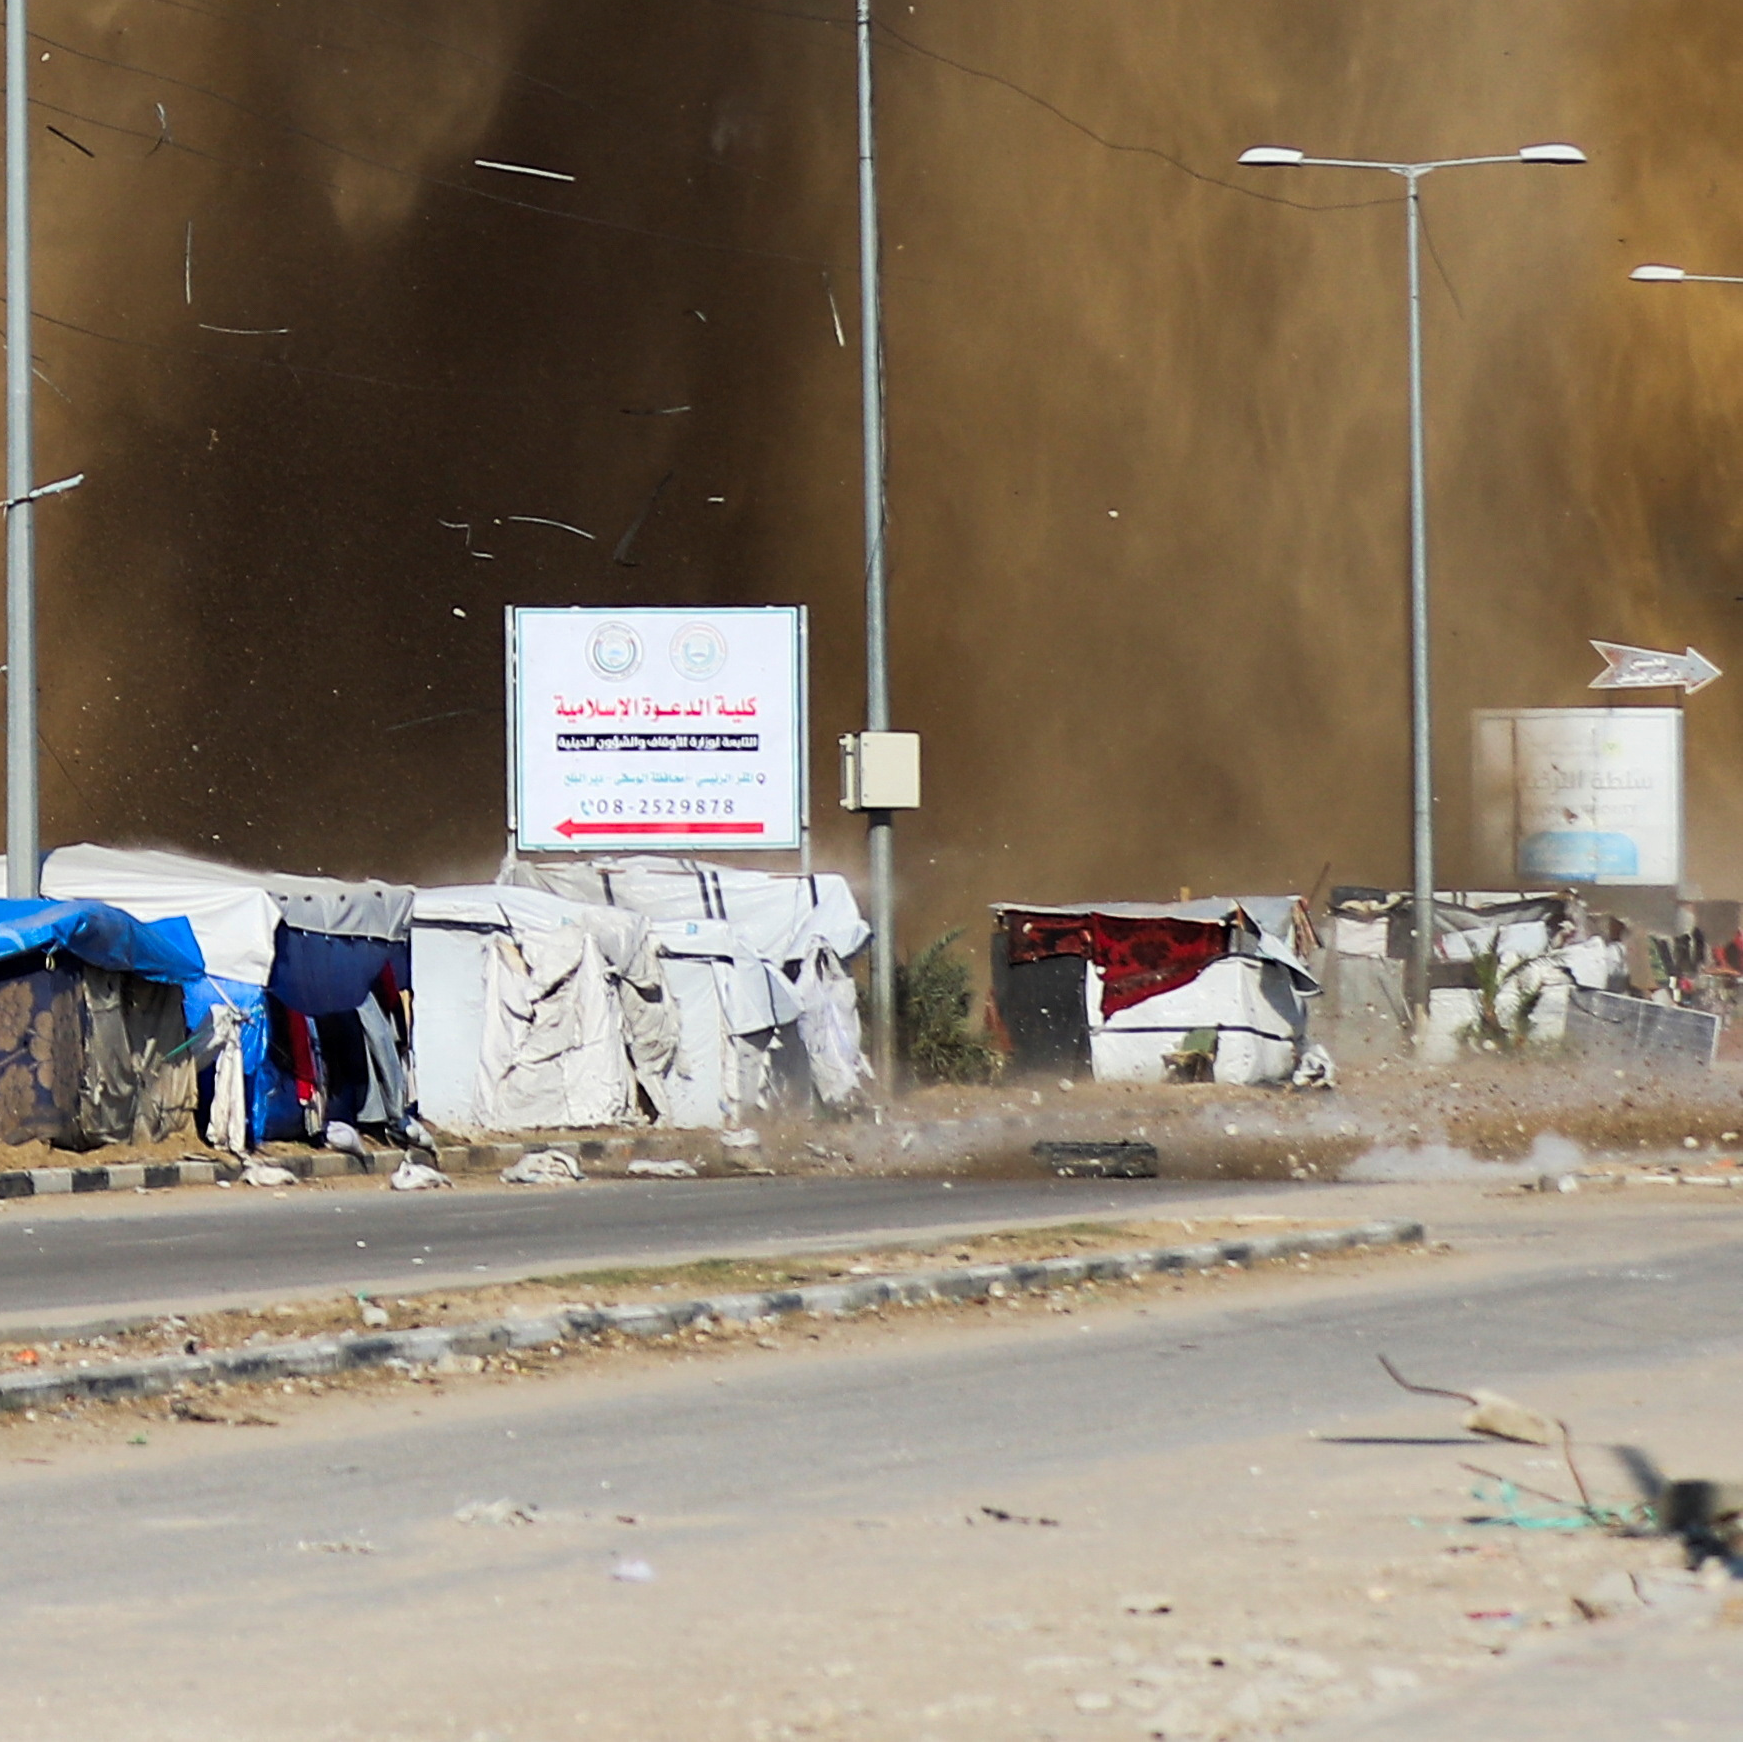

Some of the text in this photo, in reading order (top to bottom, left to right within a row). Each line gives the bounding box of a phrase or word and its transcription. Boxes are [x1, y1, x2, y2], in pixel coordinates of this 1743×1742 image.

[554, 695, 757, 724] كلية الدعوة الإسلامية
[557, 736, 596, 750] الدينية
[689, 736, 721, 751] لوزارة
[721, 736, 758, 750] التابعة
[1591, 770, 1653, 791] سلطة
[596, 799, 734, 815] 08-2529878
